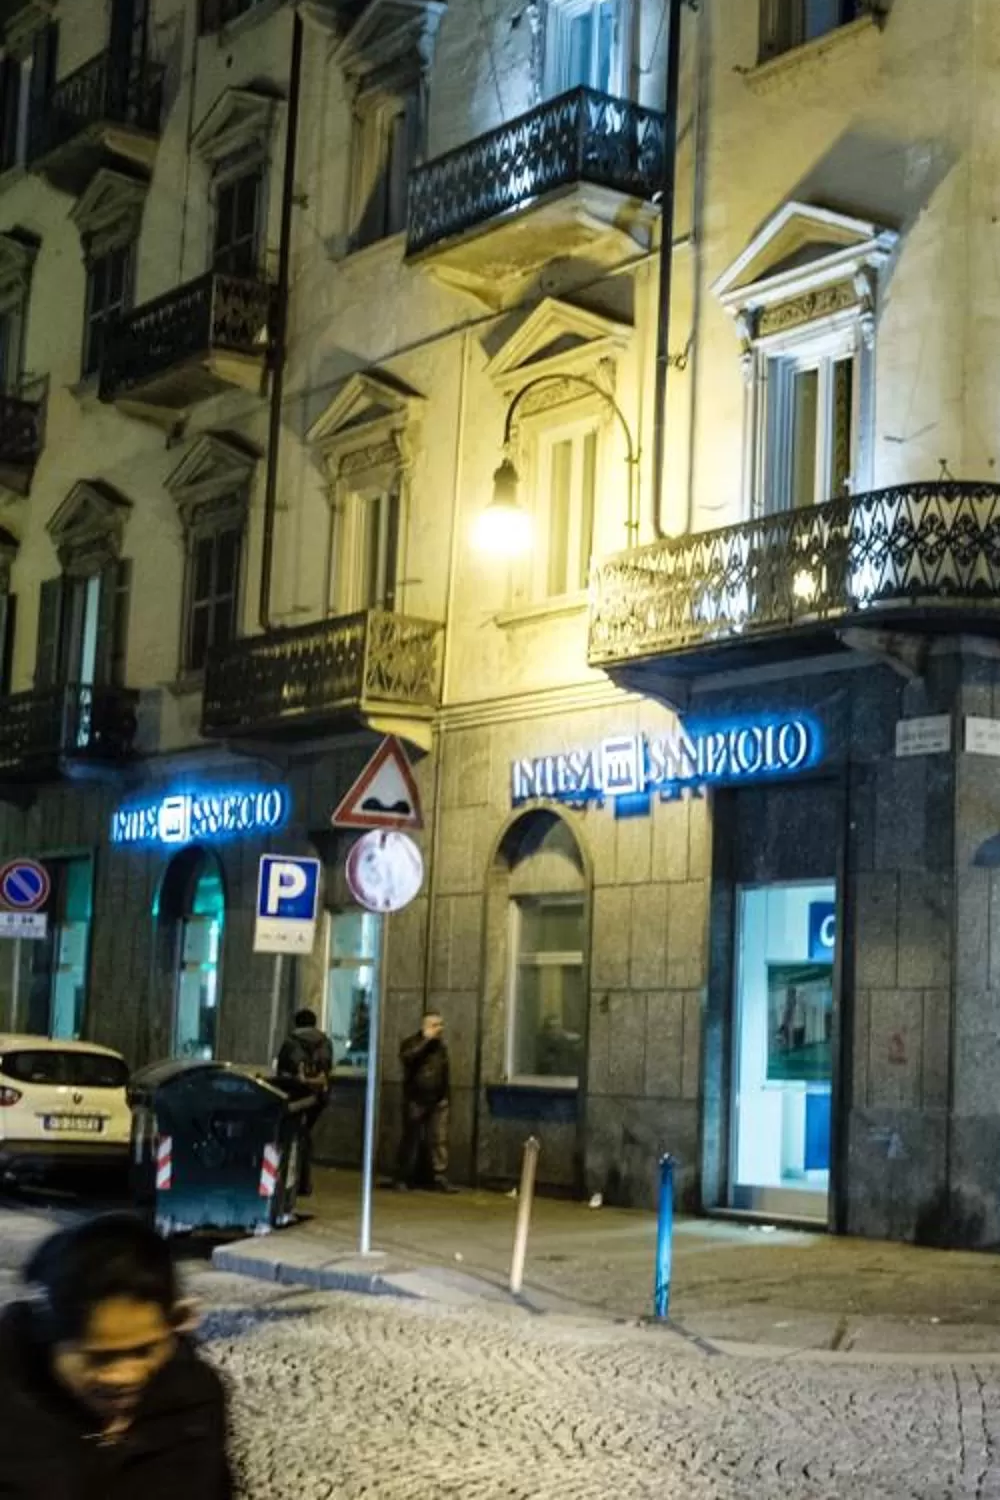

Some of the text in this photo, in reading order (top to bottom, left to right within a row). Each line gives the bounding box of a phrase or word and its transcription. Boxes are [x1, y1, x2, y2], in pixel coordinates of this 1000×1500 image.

[511, 721, 808, 798] INTESA SANPAOLO
[112, 804, 164, 842] INTES
[267, 861, 307, 914] P
